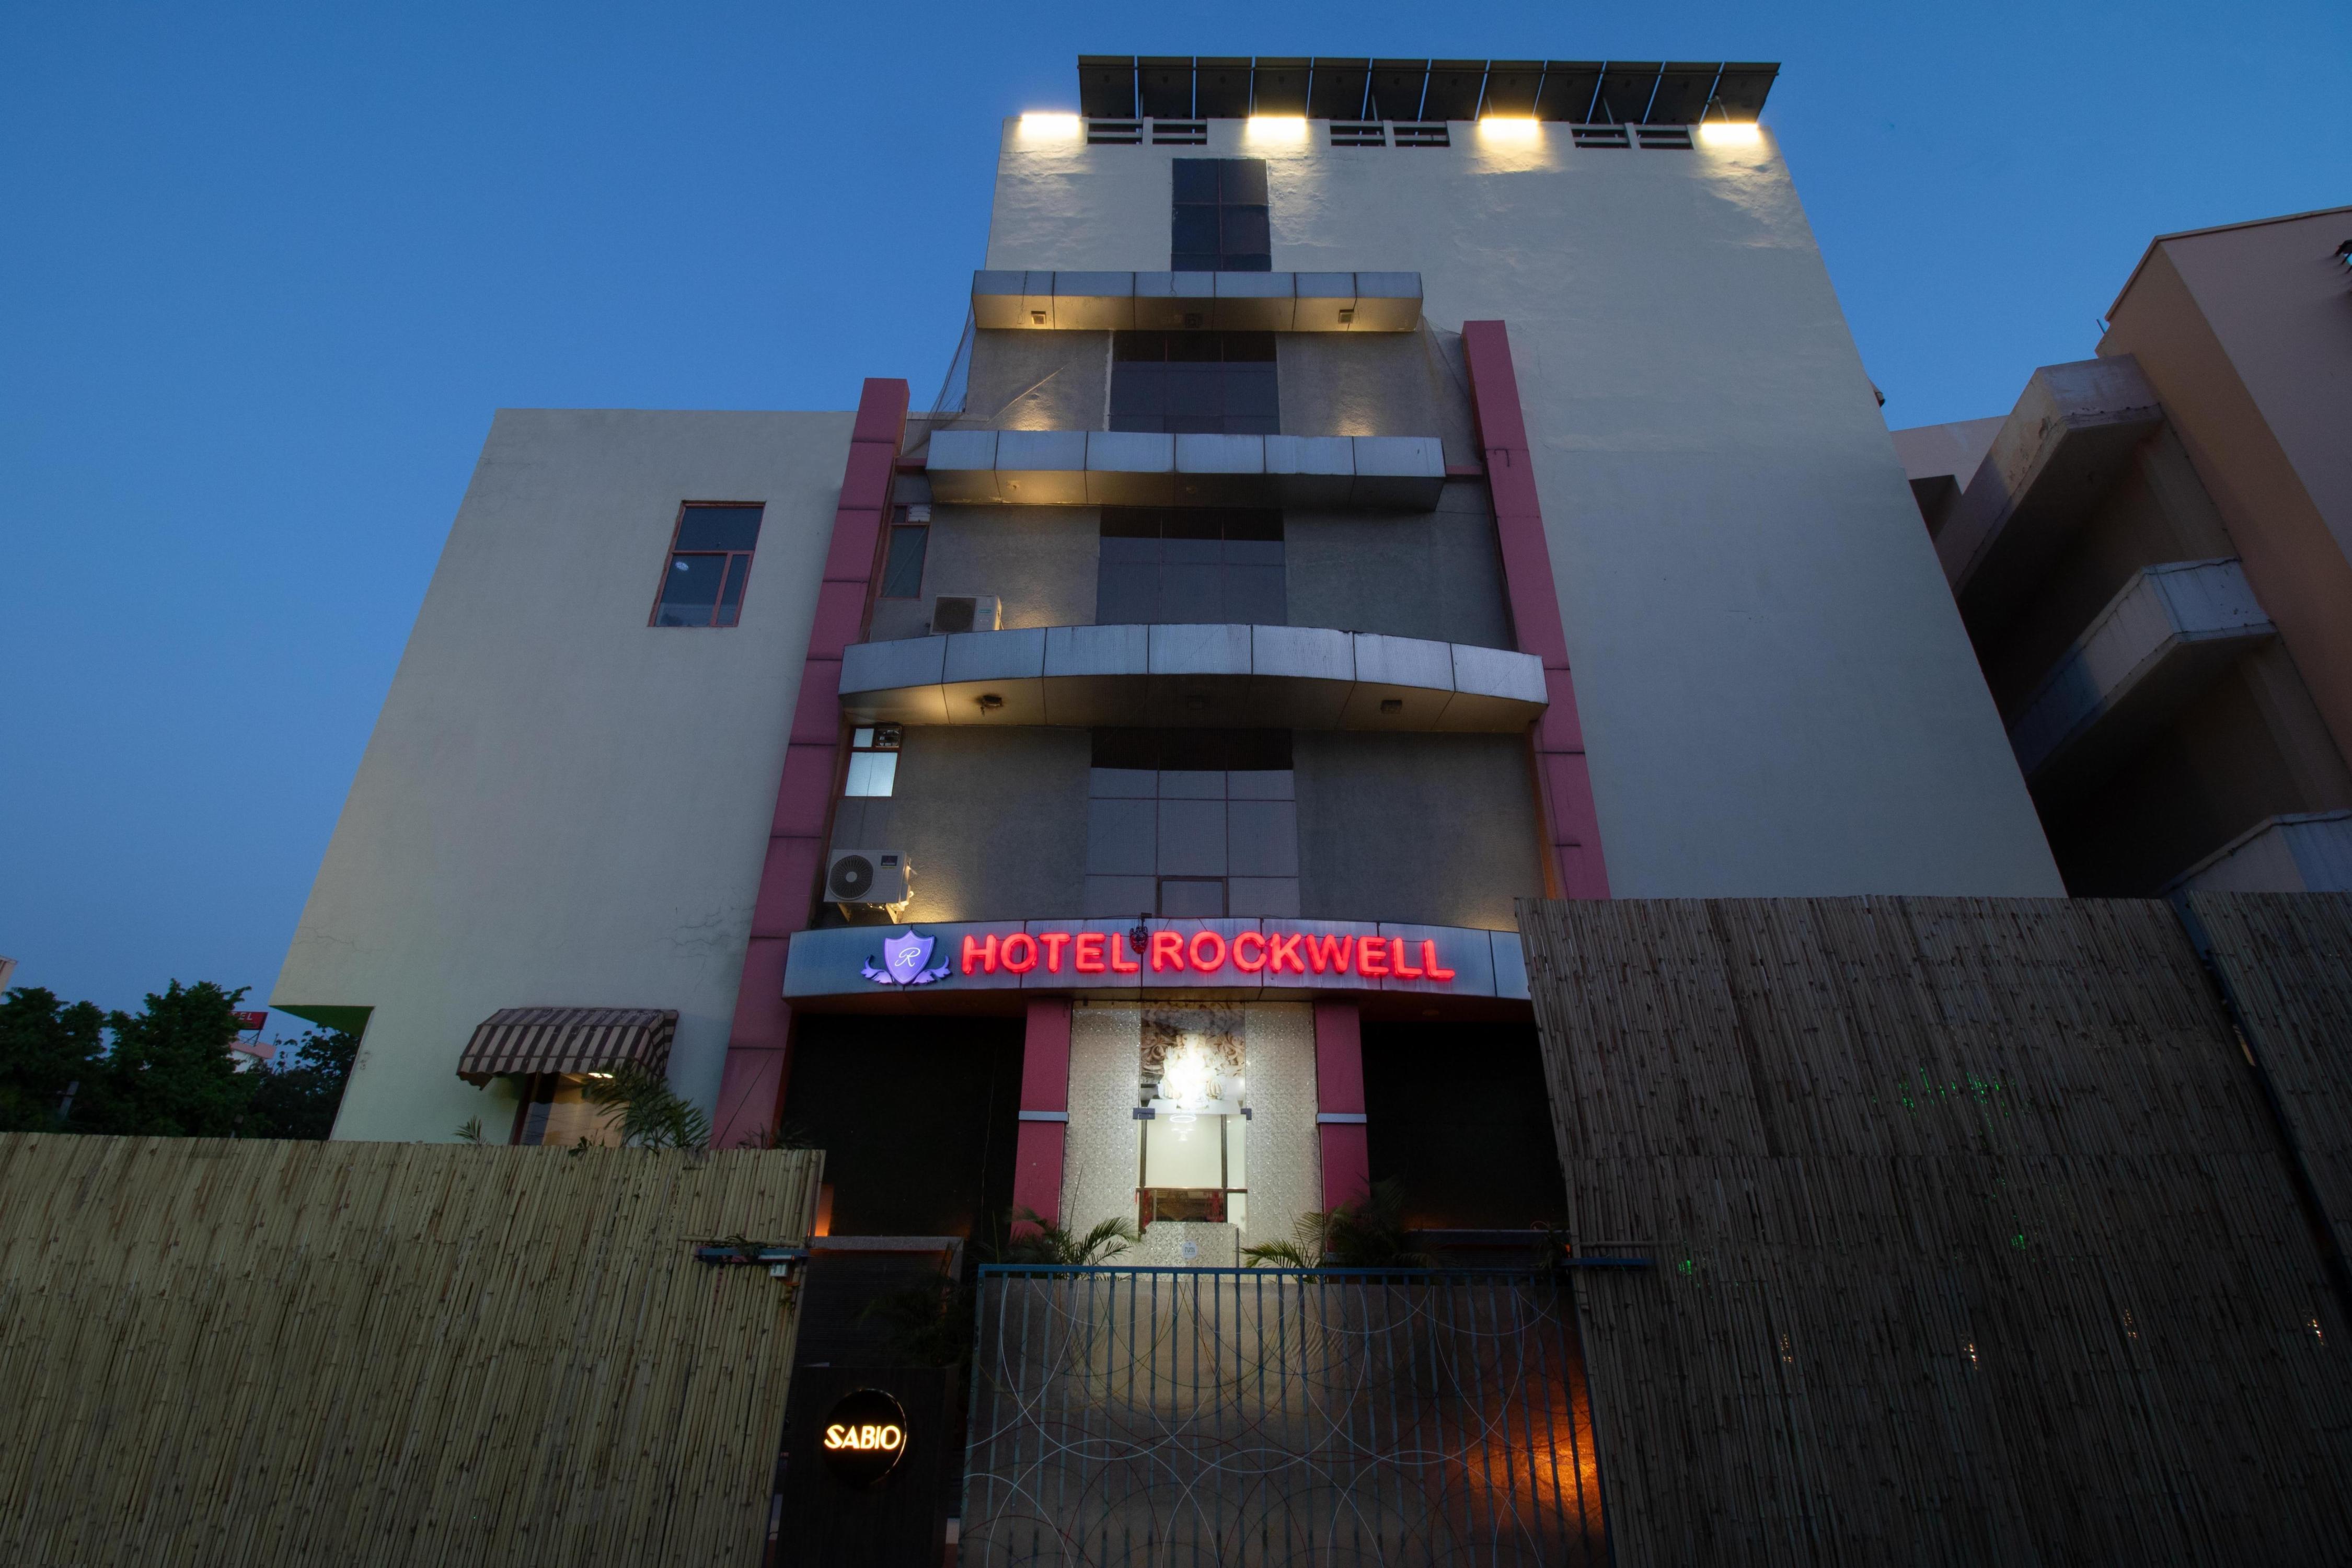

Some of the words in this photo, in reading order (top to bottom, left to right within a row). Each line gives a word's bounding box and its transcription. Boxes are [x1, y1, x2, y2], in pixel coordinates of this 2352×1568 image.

[894, 948, 920, 967] R
[962, 932, 1139, 974] HOTEL
[1152, 931, 1456, 980] ROCKWELL
[230, 1012, 252, 1020] TEL
[824, 1424, 901, 1450] SABIO
